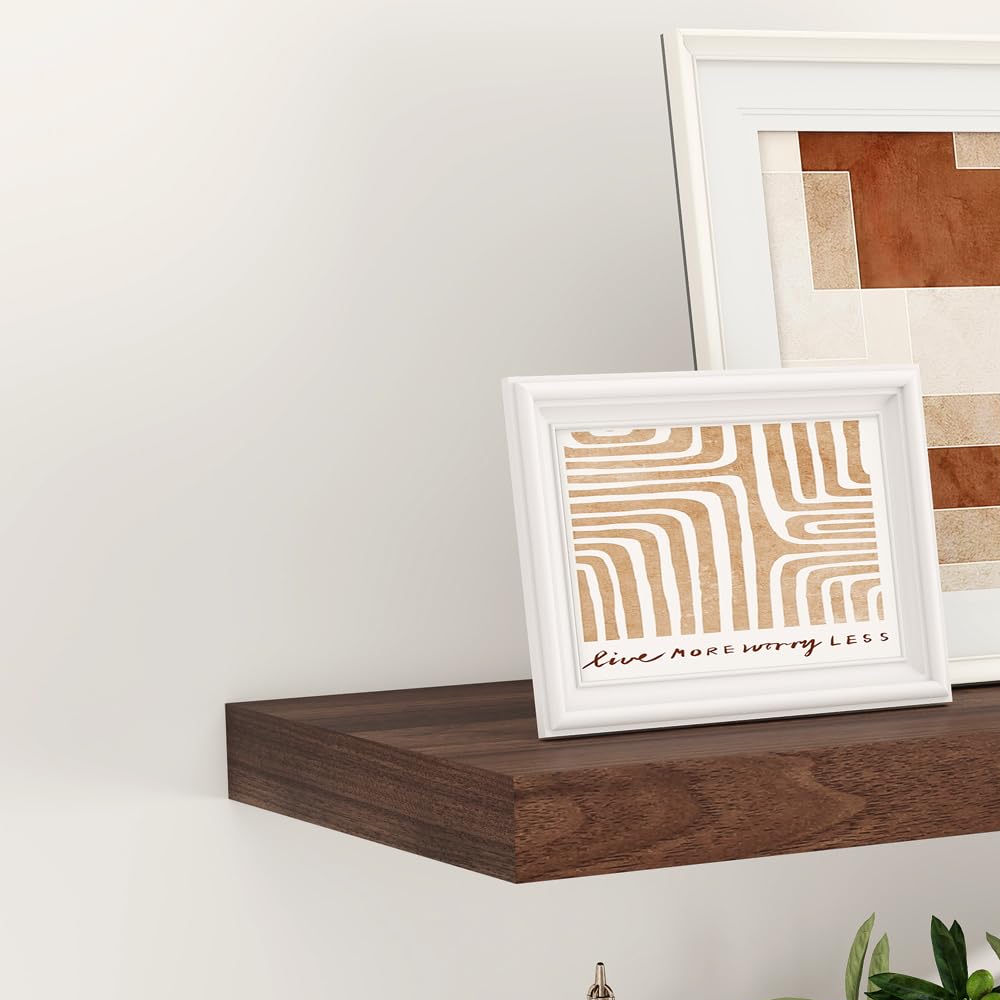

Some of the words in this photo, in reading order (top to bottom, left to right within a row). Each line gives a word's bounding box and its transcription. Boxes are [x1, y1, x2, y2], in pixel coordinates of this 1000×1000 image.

[582, 650, 666, 669] live
[671, 645, 735, 659] MORE
[742, 634, 823, 657] worry
[831, 632, 889, 646] LESS
